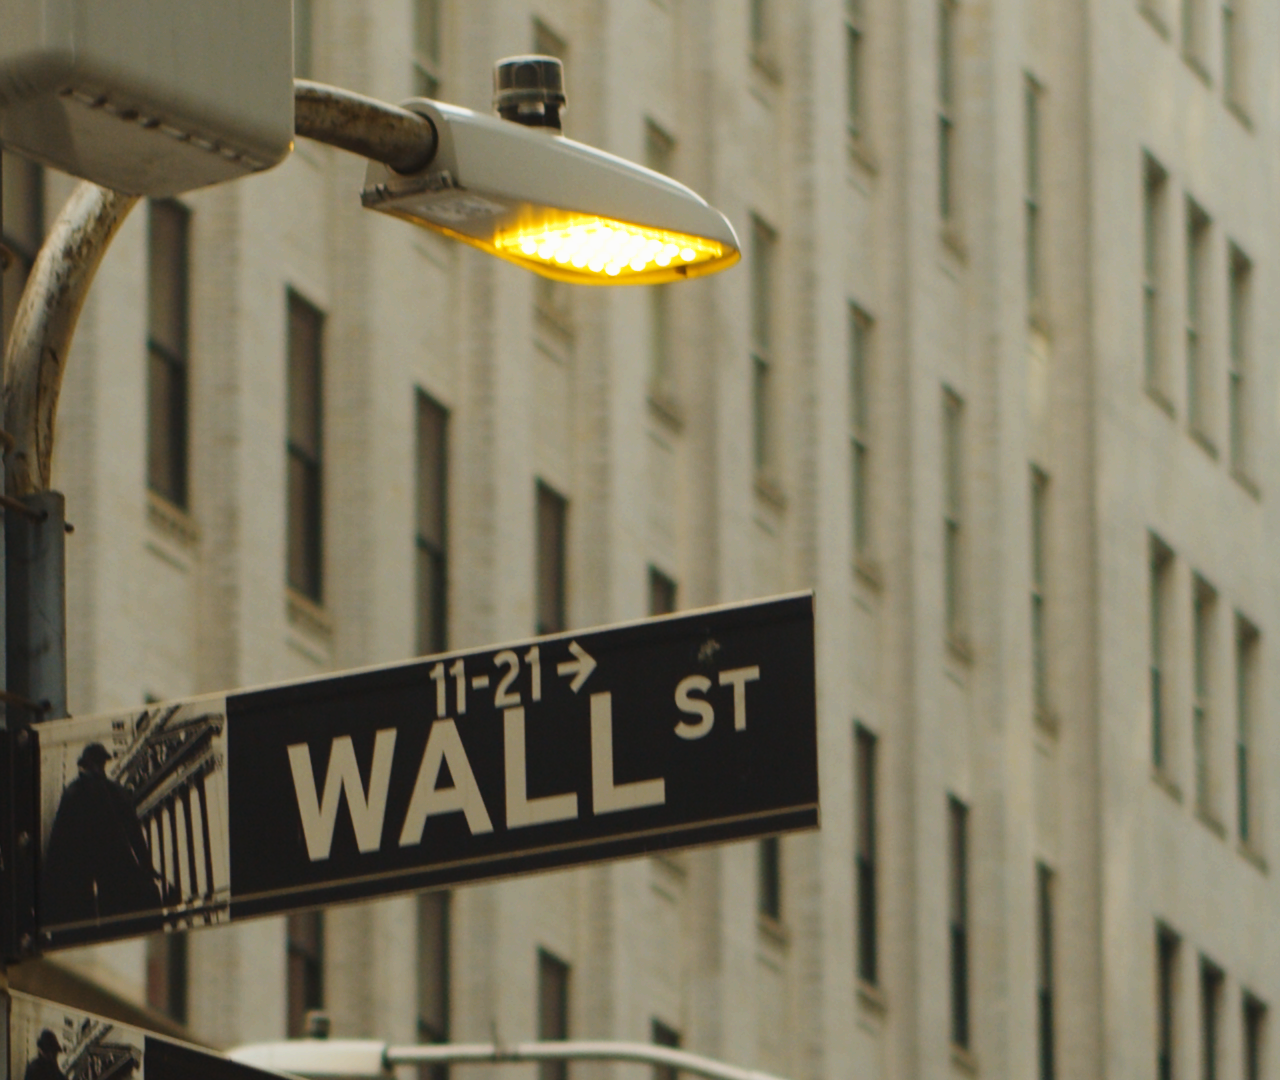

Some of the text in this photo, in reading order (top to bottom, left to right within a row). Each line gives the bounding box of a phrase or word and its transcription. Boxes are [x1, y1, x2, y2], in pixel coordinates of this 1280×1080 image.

[429, 646, 541, 717] 11-21
[287, 665, 760, 861] WALL ST
